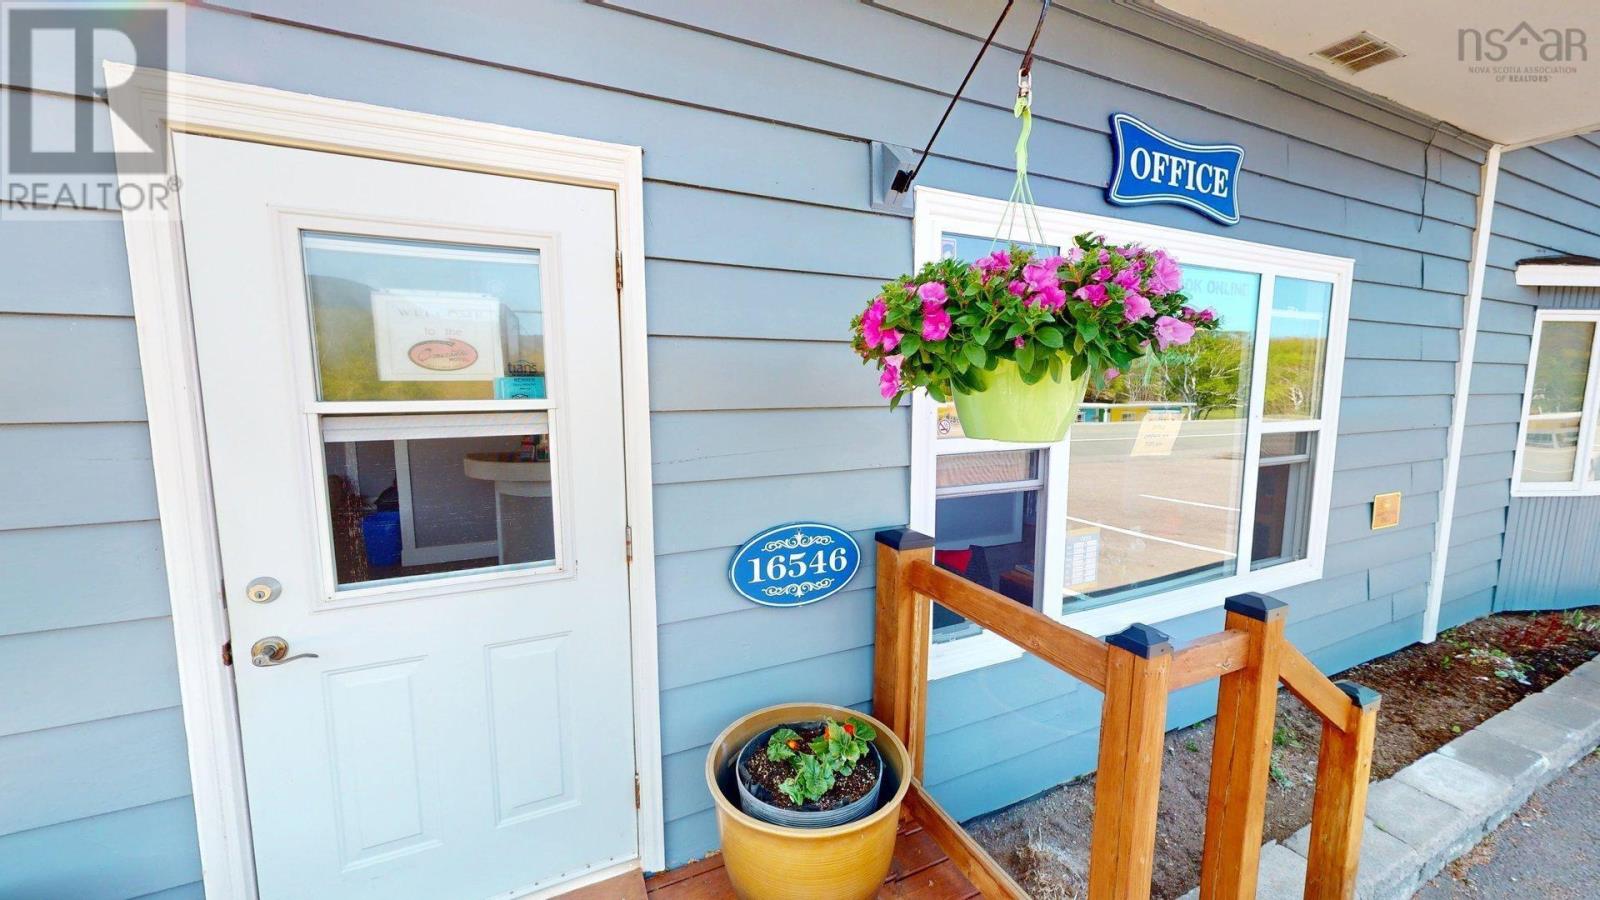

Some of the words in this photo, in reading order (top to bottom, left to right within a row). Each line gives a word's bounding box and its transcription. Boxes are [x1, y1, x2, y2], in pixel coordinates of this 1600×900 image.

[1130, 147, 1229, 198] OFFICE
[1184, 278, 1203, 294] OK
[1207, 280, 1249, 297] ONLINE
[748, 547, 848, 584] 16546
